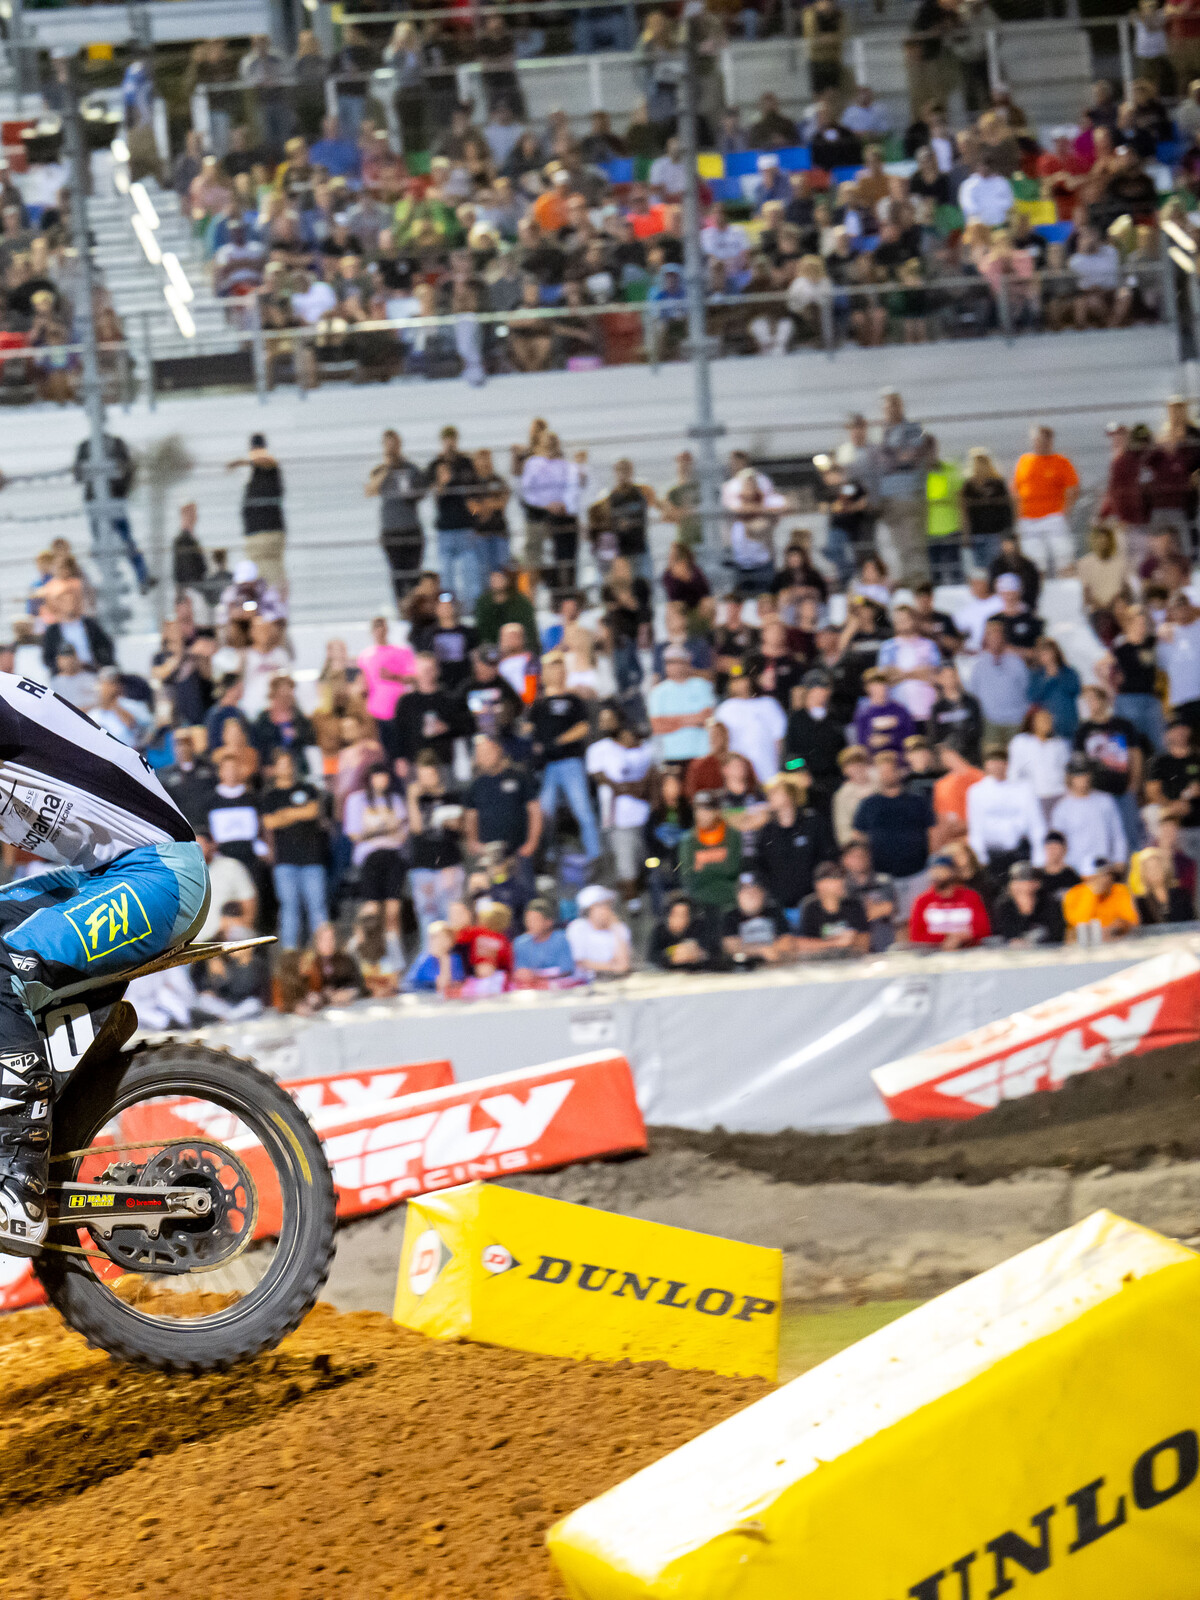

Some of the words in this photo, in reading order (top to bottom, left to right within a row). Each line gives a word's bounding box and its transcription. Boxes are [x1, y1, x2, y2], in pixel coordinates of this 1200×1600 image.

[84, 892, 129, 950] FLY
[136, 1198, 162, 1206] brembo
[359, 1149, 529, 1205] RACING
[528, 1255, 778, 1322] DUNLOP
